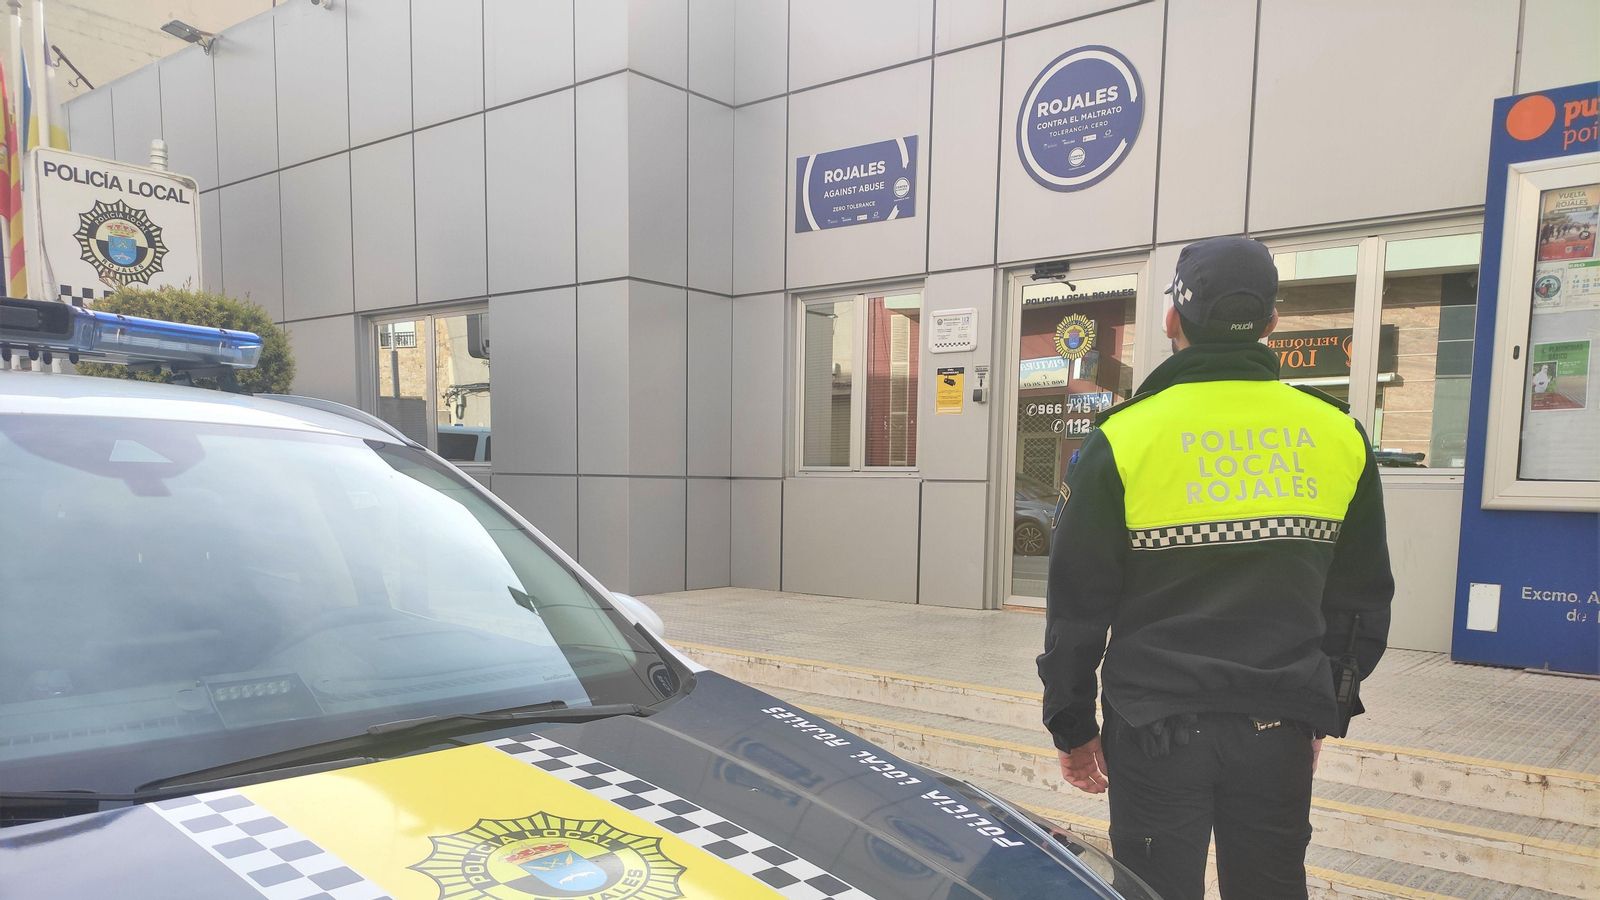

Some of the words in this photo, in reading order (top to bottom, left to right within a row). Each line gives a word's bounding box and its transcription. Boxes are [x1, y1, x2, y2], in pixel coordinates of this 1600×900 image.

[1037, 85, 1119, 118] ROJALES
[1564, 98, 1600, 127] pu
[1036, 118, 1068, 131] CONTRA
[1069, 115, 1080, 123] EL
[1080, 105, 1122, 121] MALTRATO
[1049, 125, 1089, 137] TOLERANCIA
[1090, 120, 1109, 129] CERO
[43, 160, 123, 192] POLICÍA
[128, 178, 190, 205] LOCAL
[823, 160, 886, 184] ROJALES
[823, 186, 857, 199] AGAINST
[858, 181, 885, 193] ABUSE
[1559, 191, 1586, 200] VUELTA
[832, 204, 846, 213] ZERO
[846, 200, 876, 210] TOLERANCE
[1555, 199, 1588, 209] ROJALES
[126, 215, 149, 233] LOCAL
[101, 258, 144, 273] ROJALES
[1025, 295, 1060, 305] POLICIA
[1061, 293, 1089, 302] LOCAL
[1092, 288, 1135, 300] ROJALES
[1038, 404, 1062, 415] 966
[1066, 404, 1091, 414] 715
[1066, 418, 1091, 434] 112
[1181, 427, 1317, 453] POLICIA
[1199, 451, 1305, 478] LOCAL
[1186, 475, 1318, 504] ROJALES
[1521, 586, 1581, 603] Excmo.
[760, 706, 852, 748] ROJALES
[849, 750, 923, 786] LOCAL
[920, 789, 1026, 848] POLICIA
[465, 833, 517, 884] POLICIA
[525, 829, 611, 848] LOCAL
